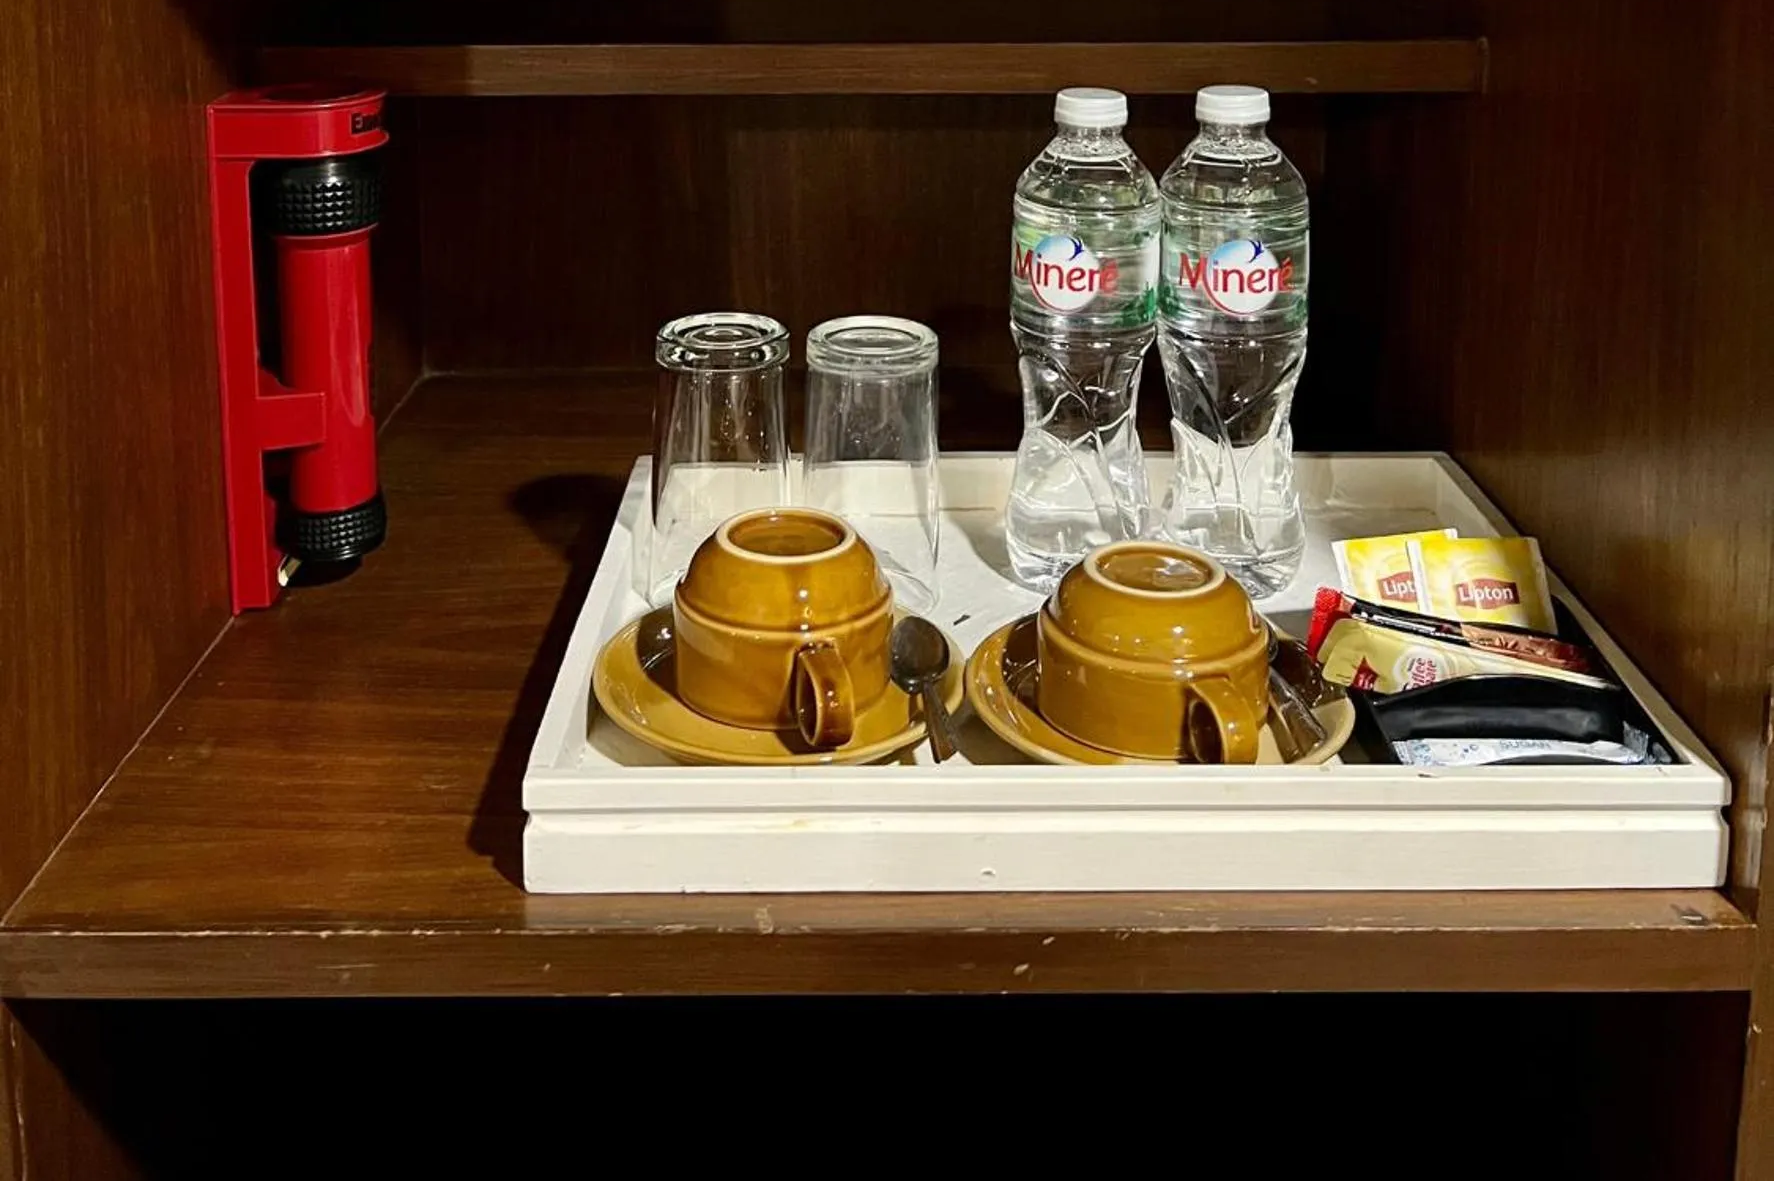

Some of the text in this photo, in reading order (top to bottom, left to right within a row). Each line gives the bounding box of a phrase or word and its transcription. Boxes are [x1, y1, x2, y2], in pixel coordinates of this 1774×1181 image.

[1179, 252, 1294, 294] Mineré
[1382, 579, 1417, 598] Lipt
[1458, 585, 1514, 603] Lipton
